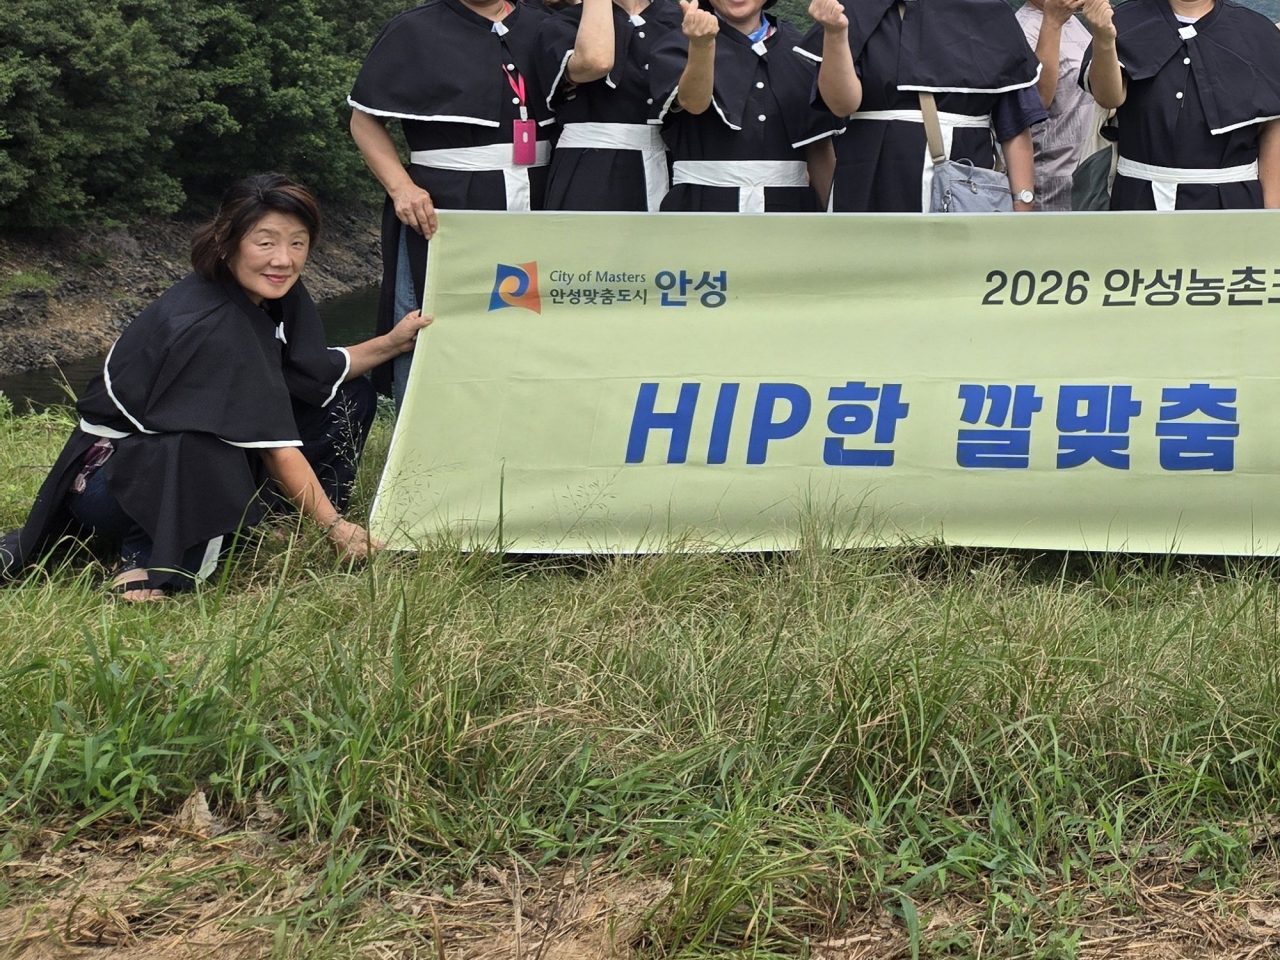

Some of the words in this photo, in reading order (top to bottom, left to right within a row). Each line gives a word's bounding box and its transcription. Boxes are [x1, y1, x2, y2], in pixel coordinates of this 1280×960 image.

[549, 270, 574, 286] City
[578, 270, 592, 283] of
[595, 270, 647, 283] Masters
[654, 269, 728, 309] 안성
[981, 269, 1090, 306] 2026
[549, 288, 648, 306] 안성맞춤도시
[624, 380, 910, 468] HIP한
[955, 382, 1240, 472] 깔맞춤
